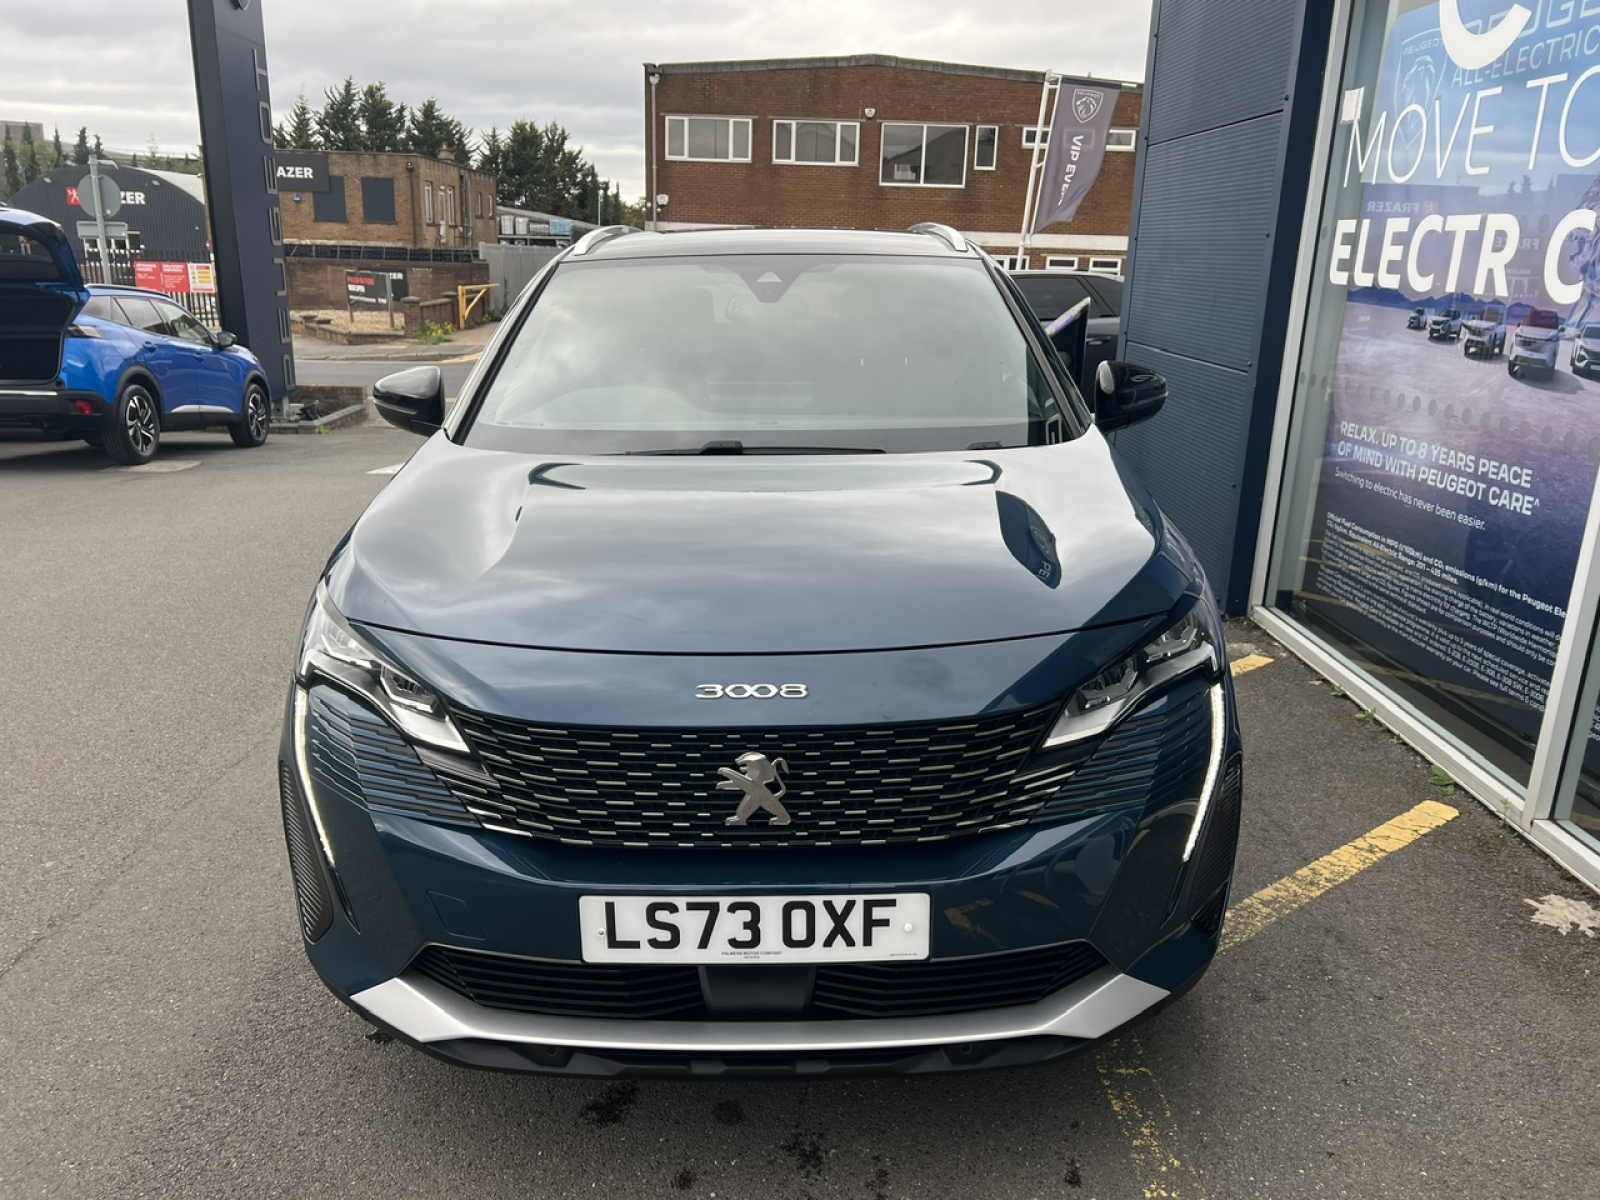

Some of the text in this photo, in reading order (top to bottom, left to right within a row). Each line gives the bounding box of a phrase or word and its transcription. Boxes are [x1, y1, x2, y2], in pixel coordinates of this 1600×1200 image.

[1343, 86, 1503, 187] MOVE
[120, 191, 146, 205] ZER
[276, 166, 313, 179] AZER
[1058, 135, 1084, 206] VIP EVE
[252, 48, 296, 391] PEUGEOT
[1338, 440, 1352, 457] OF
[1353, 444, 1383, 467] MIND
[1385, 453, 1416, 480] WITH
[1418, 466, 1486, 500] PEUGEOT
[1340, 421, 1533, 488] RELAX. UP TO 8 YEARS PEACE
[1335, 466, 1486, 531] Switching to electric has never been easier.
[1498, 584, 1509, 595] for
[1508, 588, 1521, 600] the
[1521, 593, 1553, 614] Peugeot
[695, 684, 809, 700] 3008
[605, 898, 897, 949] LS73 OXF
